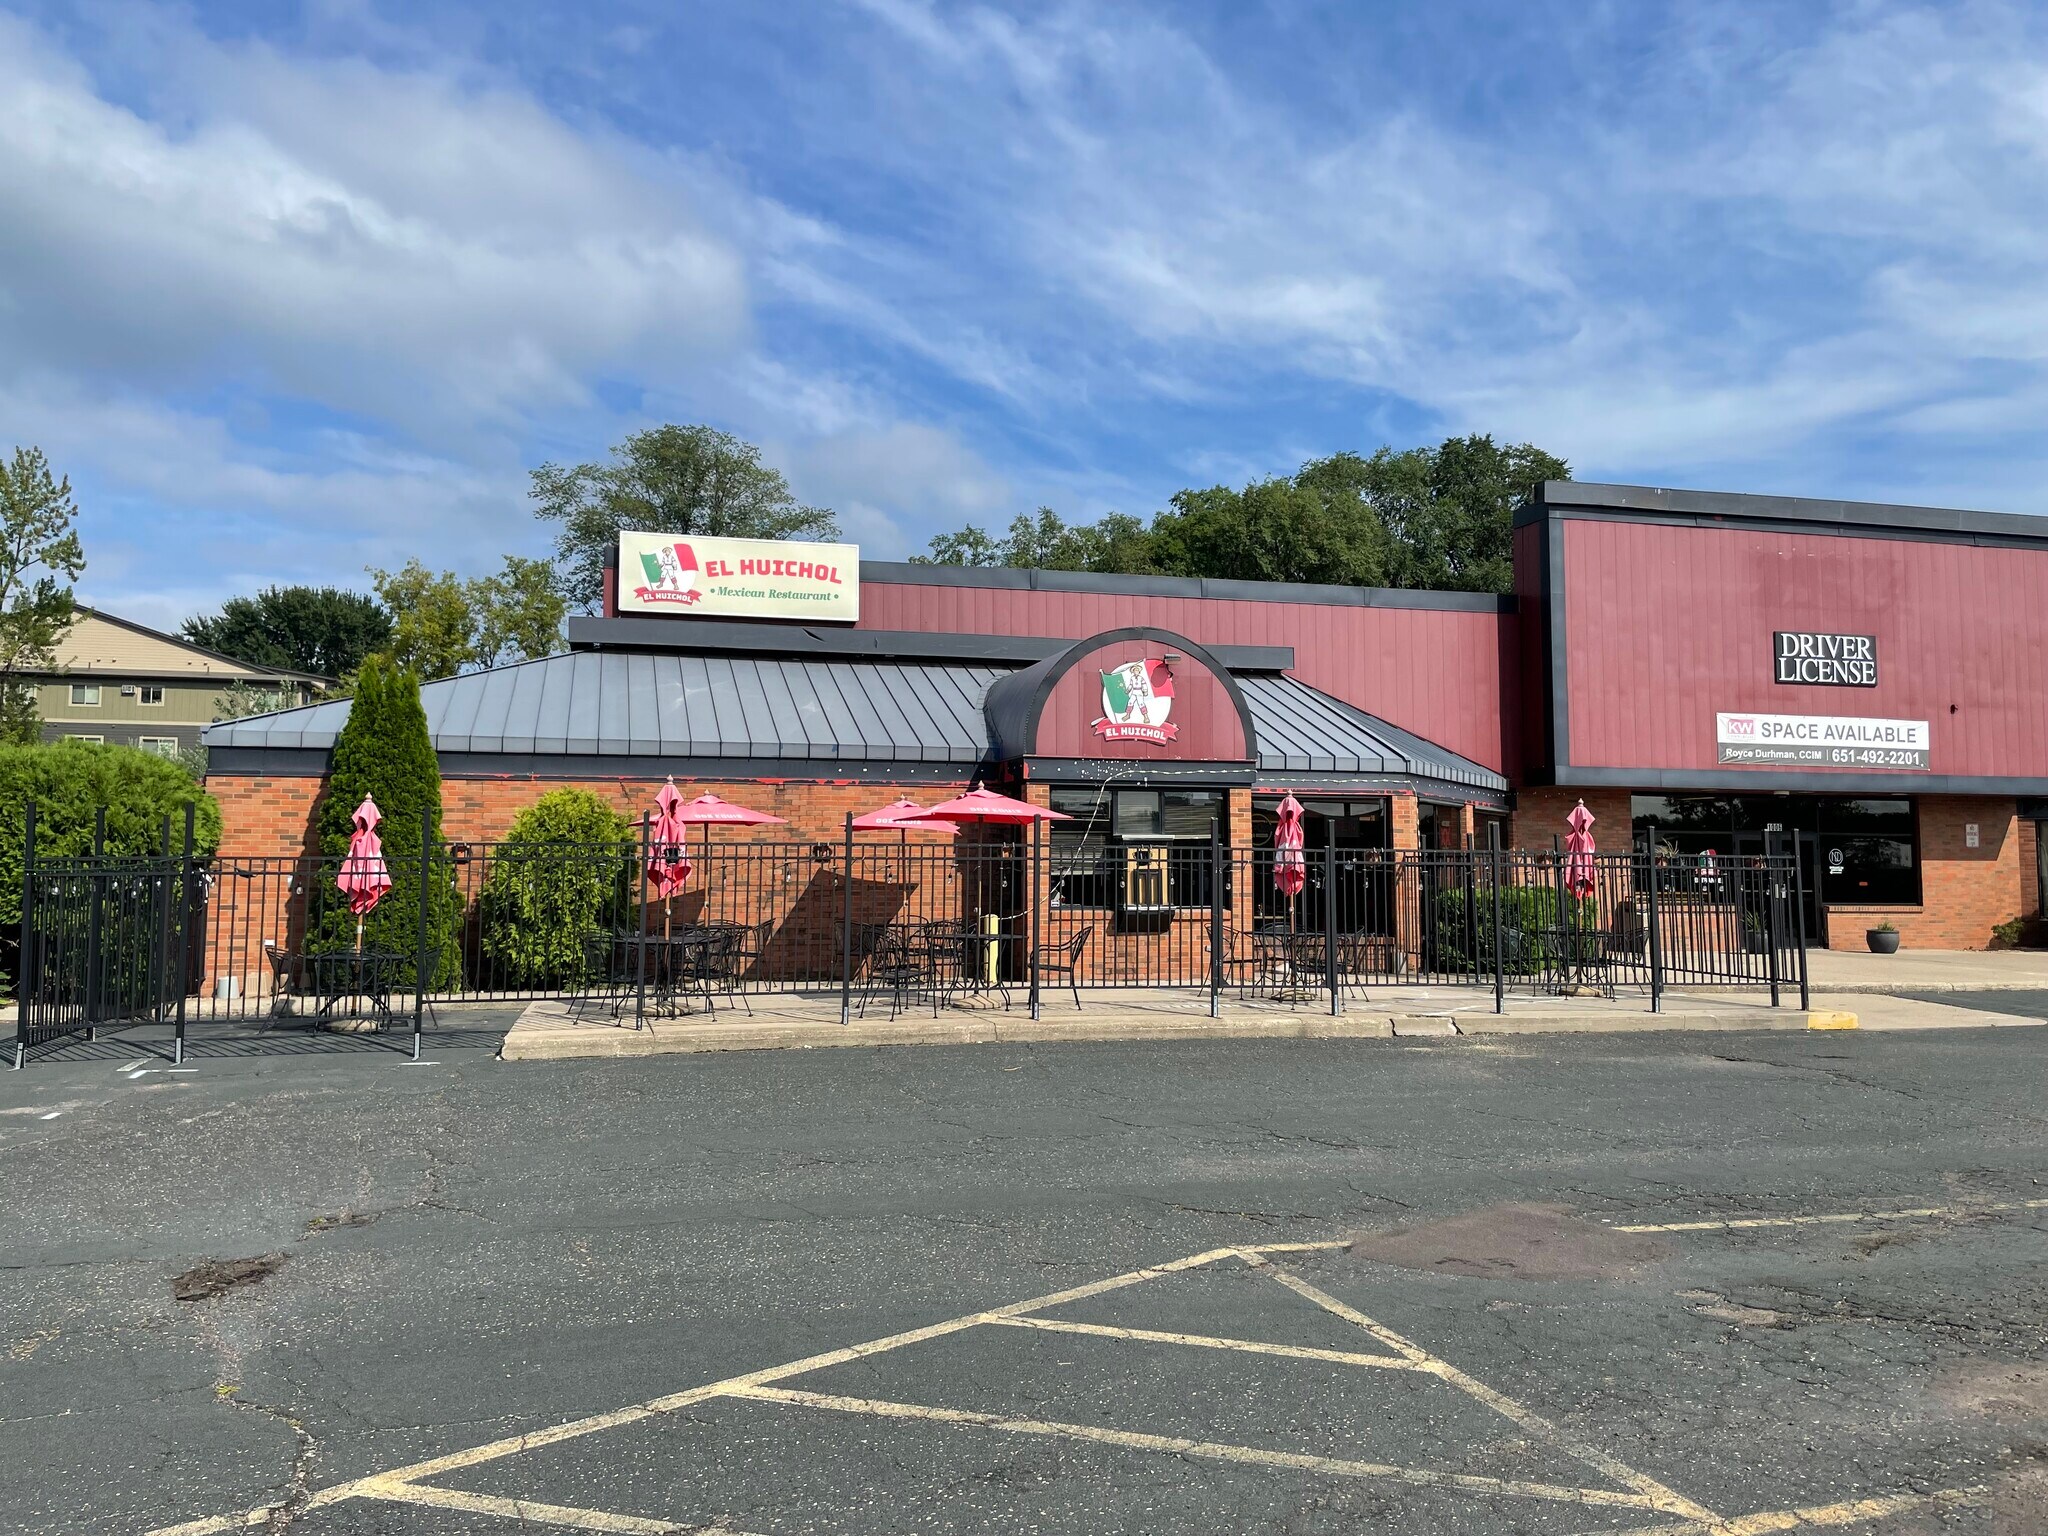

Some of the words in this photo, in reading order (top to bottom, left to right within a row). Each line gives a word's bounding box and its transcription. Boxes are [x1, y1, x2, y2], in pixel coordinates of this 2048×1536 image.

[705, 560, 734, 577] EL
[740, 559, 842, 584] HUICHOL
[643, 592, 654, 601] EL
[655, 593, 693, 603] HUICHOL
[717, 586, 765, 599] Mexican
[768, 589, 831, 601] Restaurant
[1780, 633, 1873, 660] DRIVER
[1778, 657, 1876, 684] LICENSE
[1105, 727, 1118, 737] EL
[1120, 727, 1167, 740] HUICHOL
[1728, 722, 1753, 734] KW
[1761, 722, 1818, 740] SPACE
[1824, 724, 1917, 743] AVAILABLE
[1725, 748, 1753, 758] Royce
[1755, 749, 1797, 760] Durhman,
[1799, 750, 1822, 759] CCIM
[1832, 749, 1919, 765] 651-492-2201
